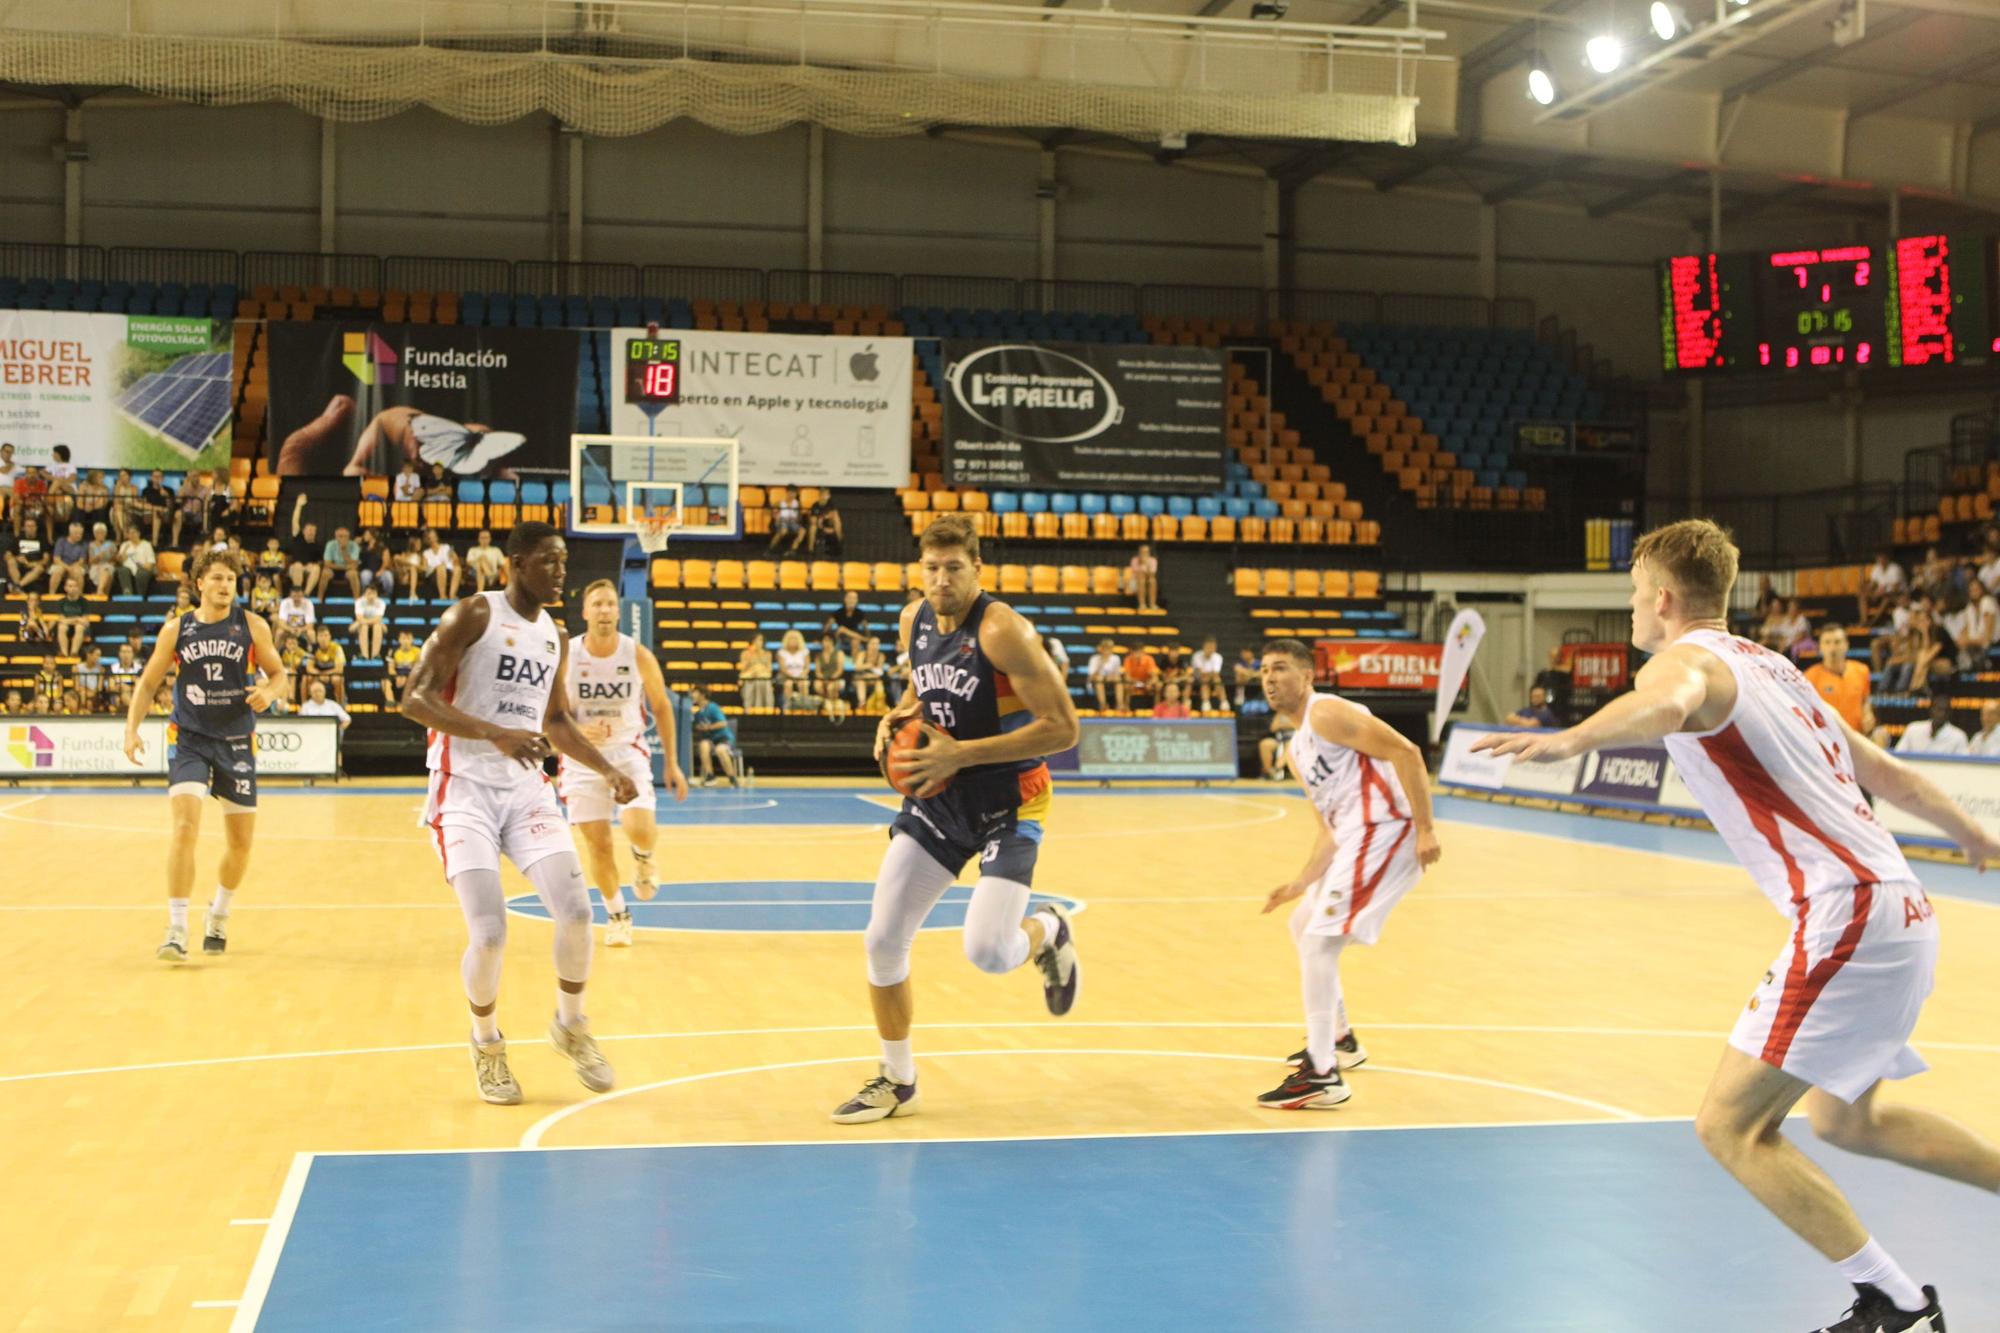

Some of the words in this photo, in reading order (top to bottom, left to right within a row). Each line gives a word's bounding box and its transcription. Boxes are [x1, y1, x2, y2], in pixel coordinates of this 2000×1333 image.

[130, 321, 173, 333] ENERGÍA
[175, 324, 208, 335] SOLAR
[404, 347, 508, 369] Fundación
[630, 340, 678, 361] 07:15
[0, 363, 91, 387] EBRER
[690, 350, 823, 379] INTECAT
[404, 369, 468, 389] Hestia
[645, 363, 674, 397] 18
[972, 373, 1007, 408] LA
[1013, 386, 1095, 411] PAELLA
[678, 395, 719, 407] perto
[724, 397, 742, 407] en
[746, 395, 791, 409] Apple
[796, 400, 805, 412] y
[808, 397, 889, 414] tecnología
[180, 639, 245, 665] MENORCA
[203, 662, 224, 681] 12
[496, 653, 553, 690] BAX
[1359, 654, 1441, 676] ESTRELL
[578, 682, 632, 699] BAXI
[930, 702, 957, 729] 55
[61, 736, 151, 751] Fundacn
[61, 754, 115, 770] Hestia
[233, 778, 252, 796] 12
